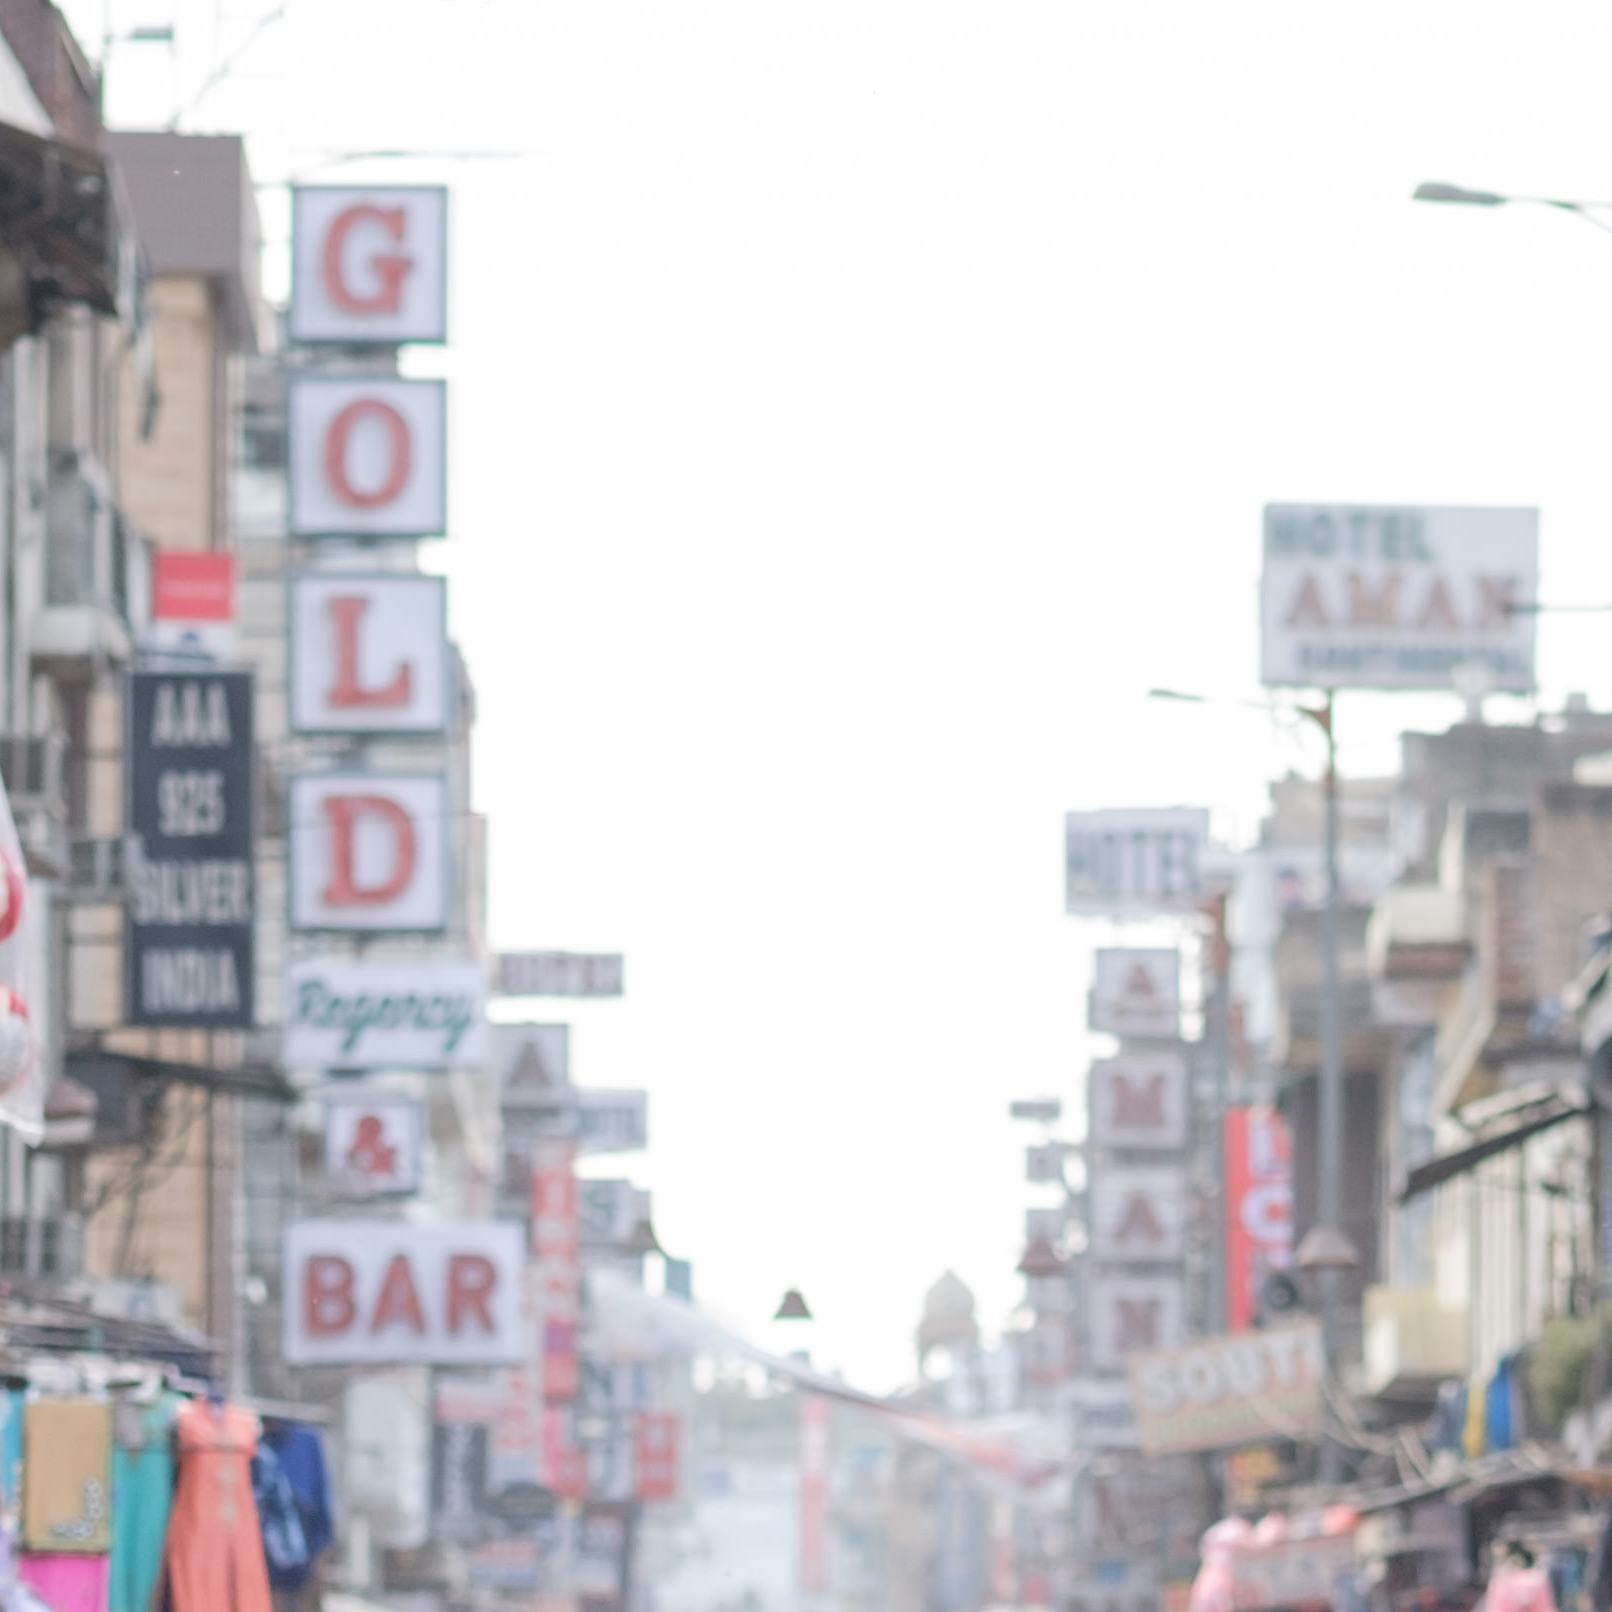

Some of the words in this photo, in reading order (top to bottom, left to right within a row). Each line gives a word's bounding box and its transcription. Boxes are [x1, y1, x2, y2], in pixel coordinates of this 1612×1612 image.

[319, 203, 418, 908] GOLD
[150, 683, 233, 747] AAA
[157, 767, 226, 837] 925
[134, 858, 251, 925] SILVER
[141, 947, 239, 1014] INDIA
[296, 976, 476, 1054] Regency
[348, 1114, 397, 1175] &
[301, 1252, 500, 1340] BAR
